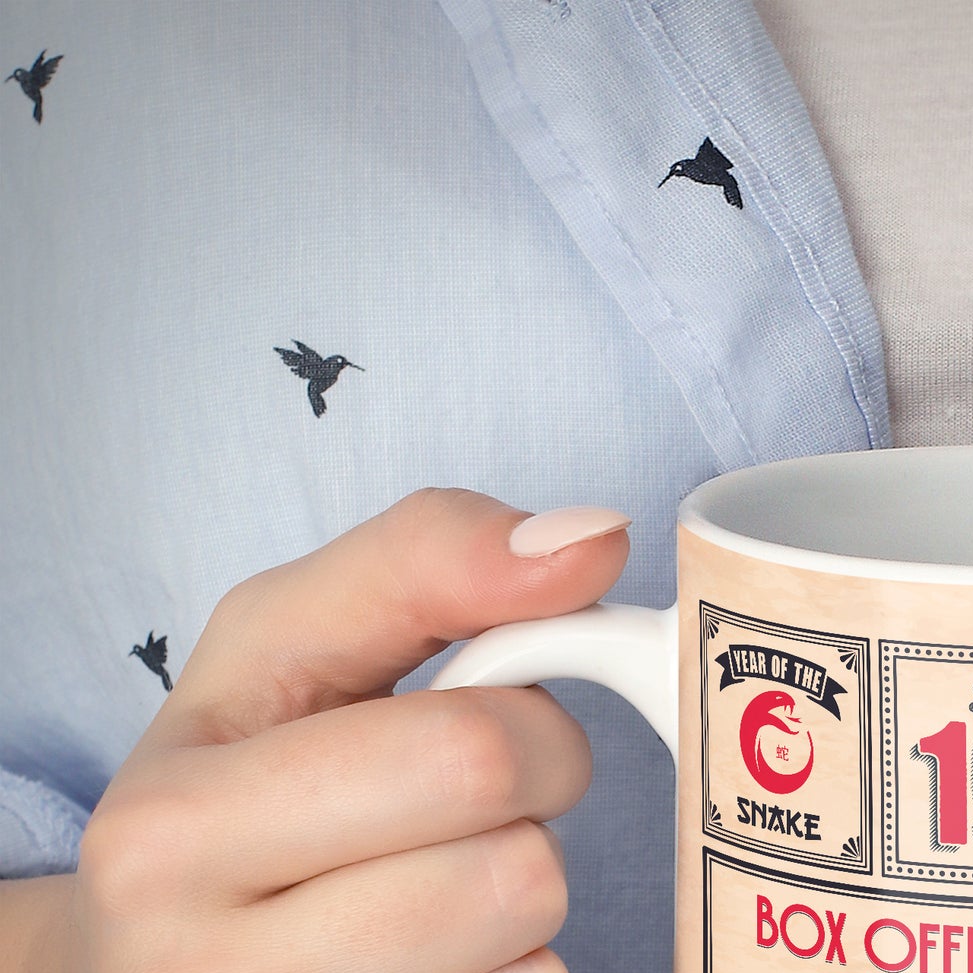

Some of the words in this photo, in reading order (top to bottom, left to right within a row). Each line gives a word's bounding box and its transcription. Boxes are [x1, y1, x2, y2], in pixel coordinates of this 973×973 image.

[733, 649, 767, 676] YEAR
[771, 654, 789, 679] OF
[793, 662, 823, 694] THE
[736, 795, 823, 841] SNAKE
[756, 895, 848, 966] BOX
